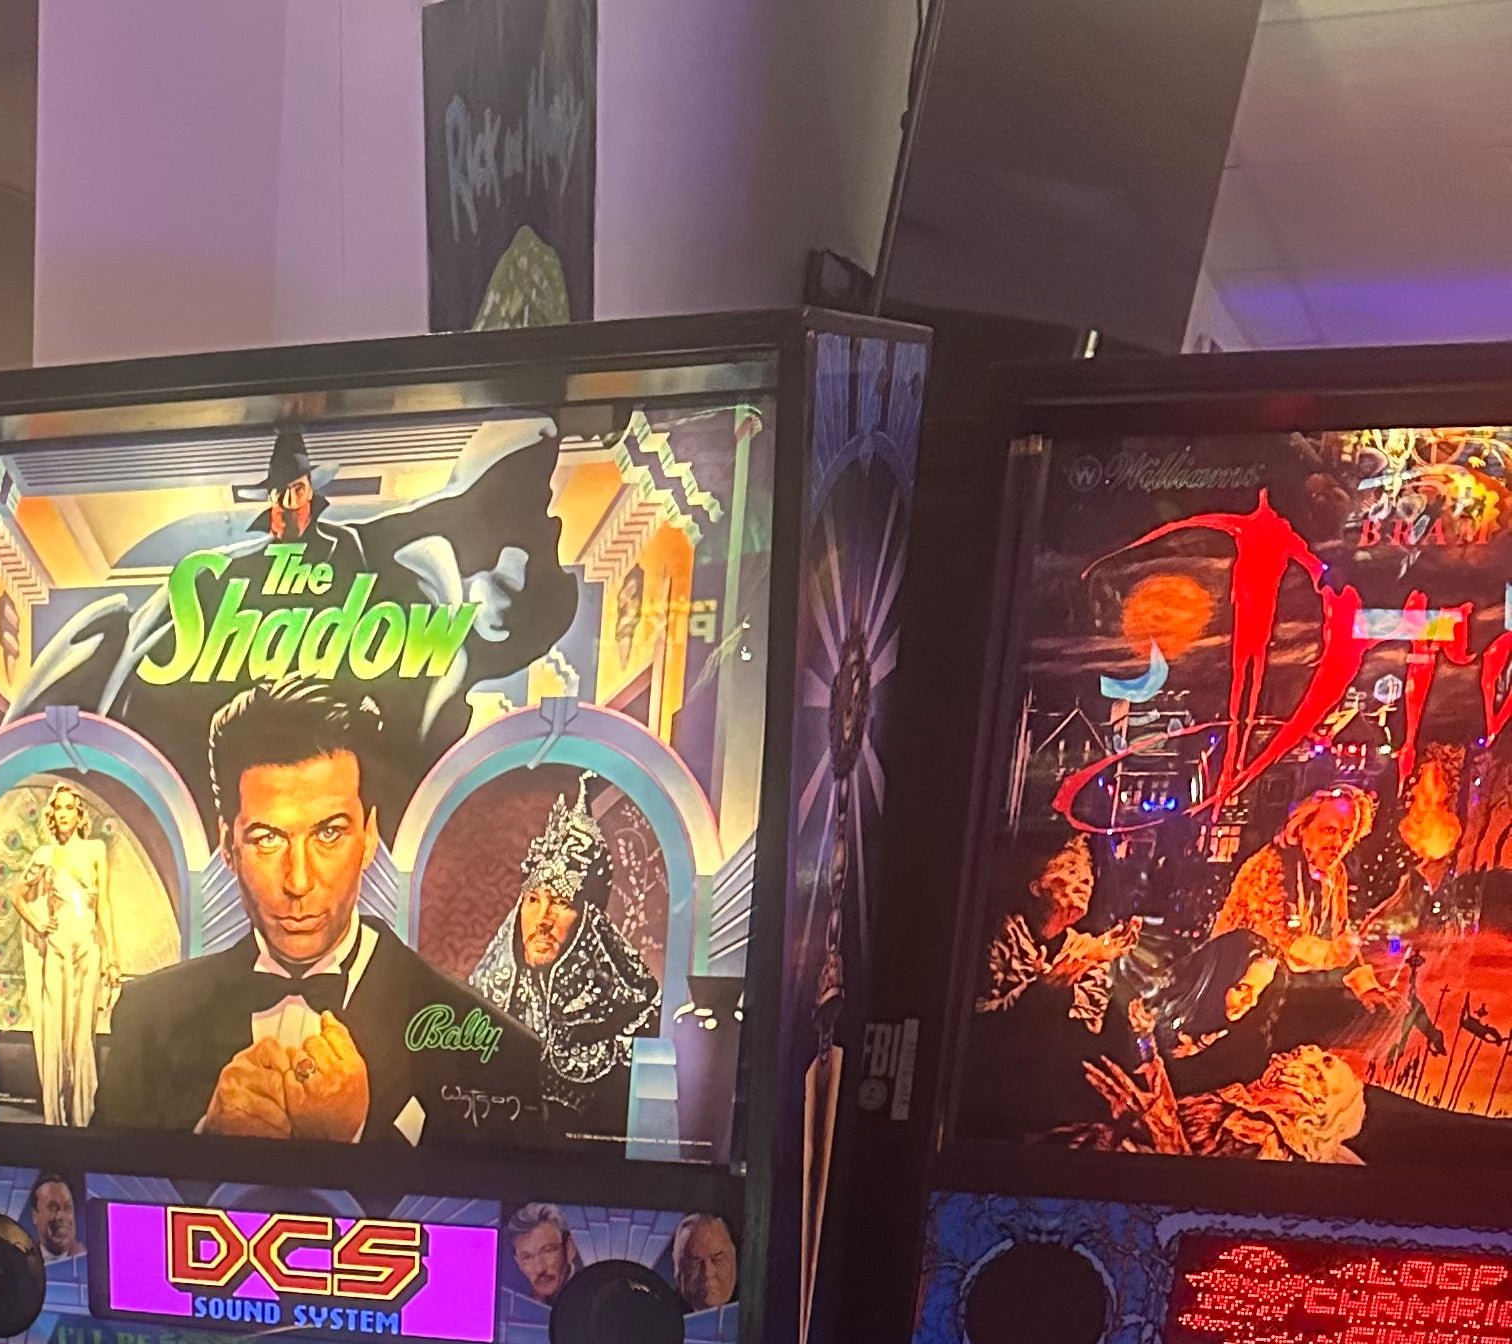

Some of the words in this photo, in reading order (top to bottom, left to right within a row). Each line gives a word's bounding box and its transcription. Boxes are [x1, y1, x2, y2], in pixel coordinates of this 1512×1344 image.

[1104, 451, 1267, 493] Williams
[1358, 519, 1491, 549] BRAM
[261, 542, 334, 595] The
[136, 549, 482, 685] Shadow
[404, 1003, 504, 1063] Bally
[166, 1206, 423, 1301] DCS
[1367, 1257, 1509, 1291] LOOP
[194, 1296, 281, 1325] SOUND
[294, 1304, 403, 1335] SYSTEM
